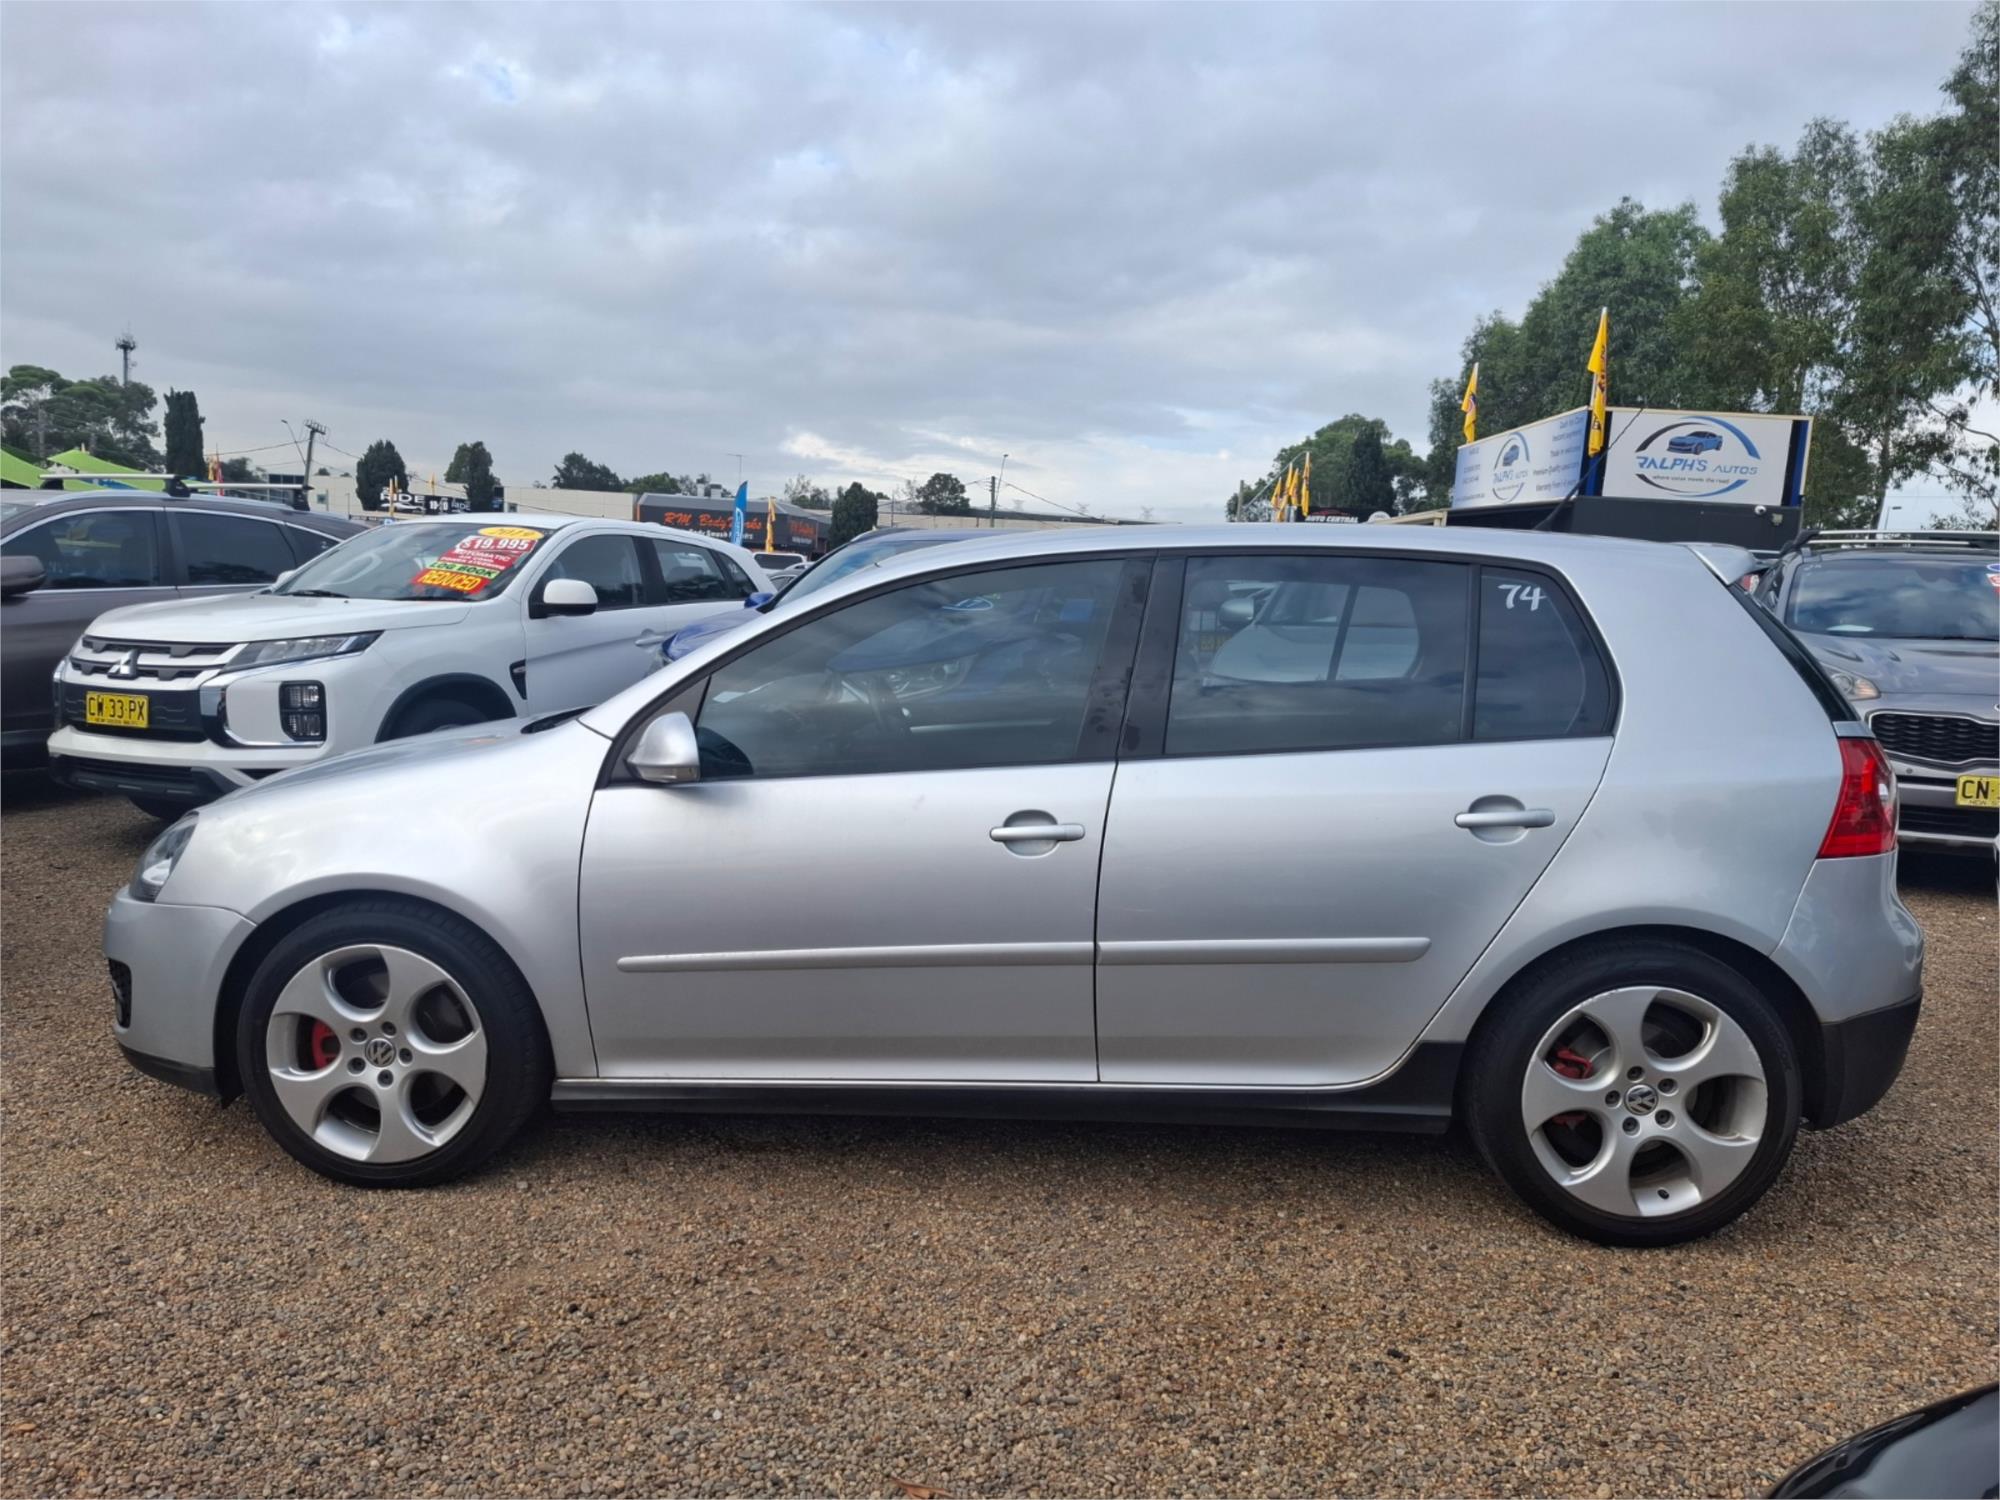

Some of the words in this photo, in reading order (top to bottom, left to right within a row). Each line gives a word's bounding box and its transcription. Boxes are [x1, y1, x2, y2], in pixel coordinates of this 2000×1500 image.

[1636, 456, 1708, 472] RALPH'S
[1713, 465, 1758, 475] AUTOS
[418, 569, 481, 591] REDUCED
[459, 565, 496, 577] BOOK
[1497, 584, 1547, 612] 74
[129, 700, 145, 721] PX
[1962, 780, 1990, 800] CN
